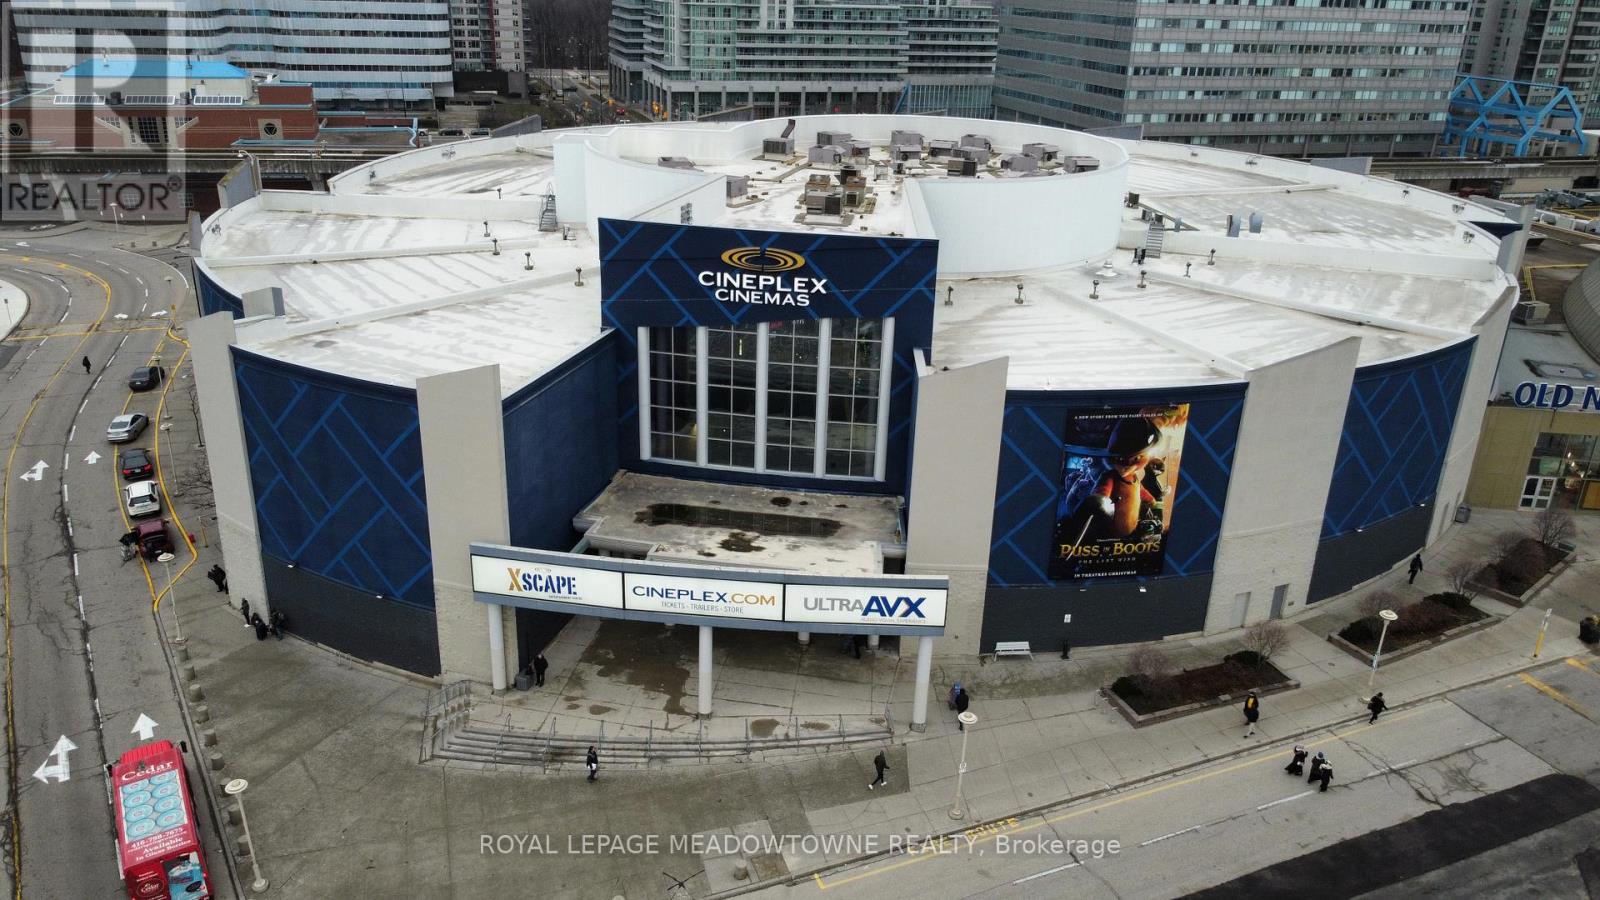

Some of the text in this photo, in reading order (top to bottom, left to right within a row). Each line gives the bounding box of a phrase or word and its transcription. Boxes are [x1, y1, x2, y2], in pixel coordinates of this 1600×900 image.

[698, 271, 828, 294] CINEPLEX
[714, 288, 810, 307] CINEMAS
[1514, 382, 1574, 408] OLD
[1060, 543, 1100, 558] PUSS
[1113, 541, 1161, 555] BOOTS
[506, 567, 578, 595] XSCAPE
[632, 585, 776, 606] CINEPLEX.COM
[661, 601, 744, 614] TICKETS TRAILERS STORE
[121, 761, 174, 782] Cedar
[143, 837, 184, 854] Available
